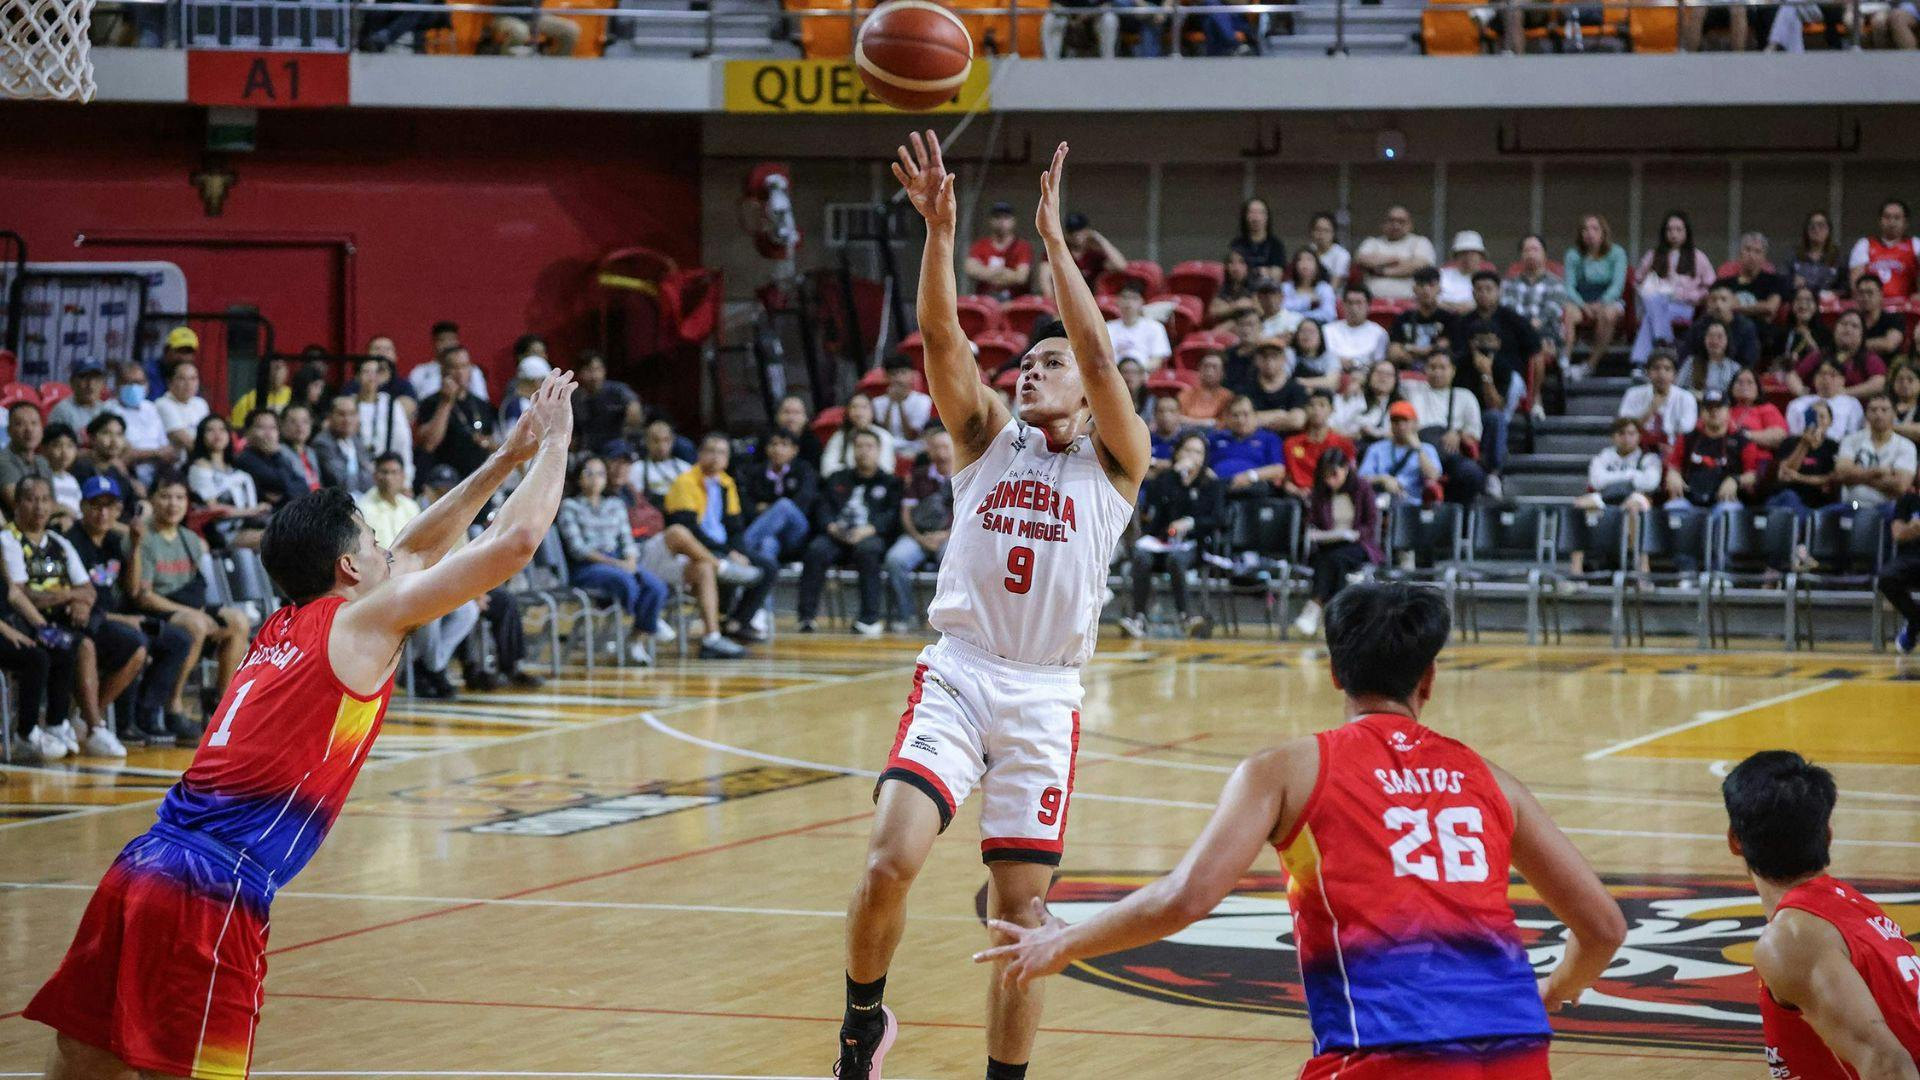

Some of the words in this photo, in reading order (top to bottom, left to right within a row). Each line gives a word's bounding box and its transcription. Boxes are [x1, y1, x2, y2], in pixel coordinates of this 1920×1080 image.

[242, 57, 300, 99] A1
[976, 479, 1077, 532] GINEBRA
[982, 512, 1015, 535] SAN
[1017, 518, 1069, 543] MIGUEL
[1004, 545, 1035, 595] 9
[207, 678, 257, 747] 1
[1037, 786, 1063, 826] 9
[1383, 805, 1490, 883] 26
